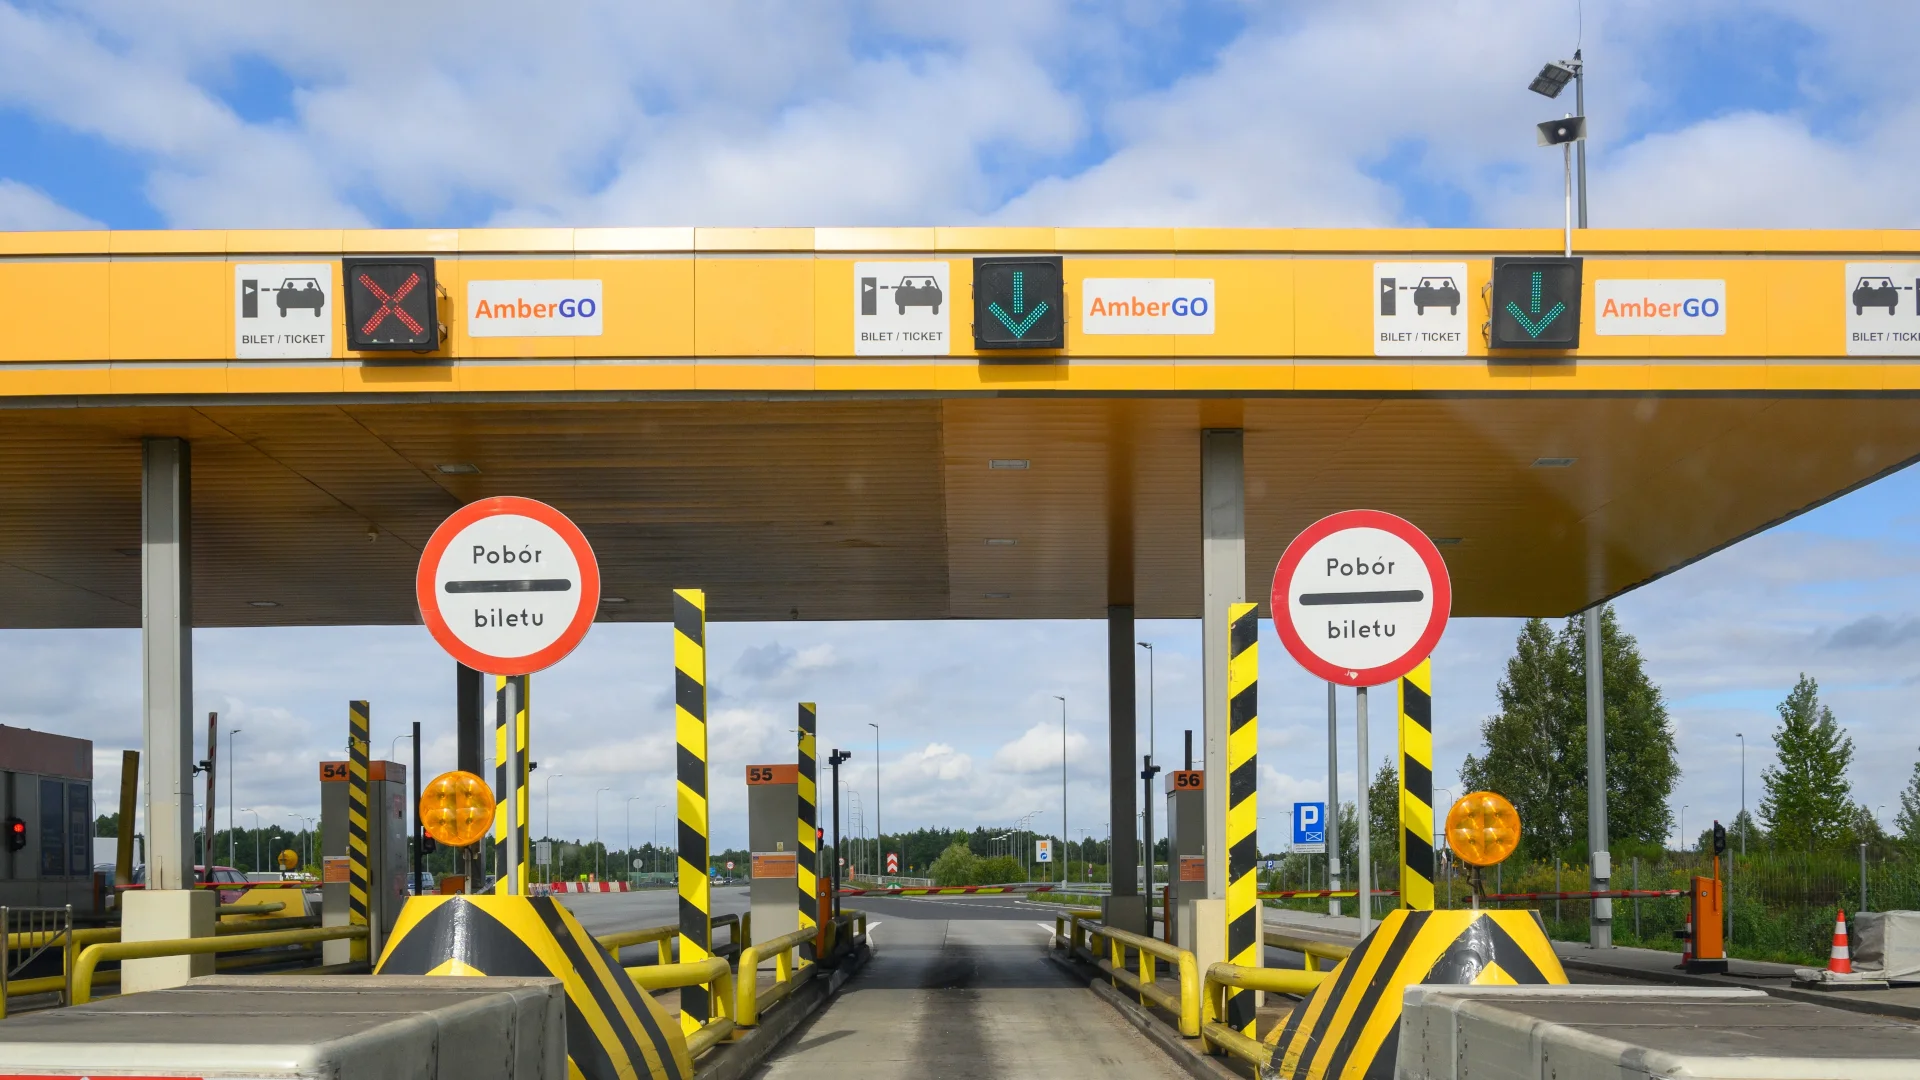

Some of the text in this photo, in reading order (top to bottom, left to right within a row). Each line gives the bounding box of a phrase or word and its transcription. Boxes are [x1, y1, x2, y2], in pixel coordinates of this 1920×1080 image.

[474, 297, 596, 319] AmberGO
[1089, 296, 1209, 317] AmberGO
[1602, 297, 1720, 318] AmberGO
[242, 334, 275, 344] BILET
[285, 334, 326, 344] TICKET
[861, 332, 893, 342] BILET
[903, 332, 942, 342] TICKET
[1380, 332, 1412, 342] BILET
[1421, 332, 1461, 342] TICKET
[1852, 332, 1884, 342] BILET
[1892, 332, 1920, 342] TICK
[473, 544, 542, 564] Pobór
[1327, 556, 1395, 577] Pobór
[474, 608, 544, 628] biletu
[1328, 619, 1396, 639] biletu
[323, 764, 347, 778] 54
[749, 767, 773, 781] 55
[1177, 773, 1200, 787] 56
[1300, 805, 1319, 832] P
